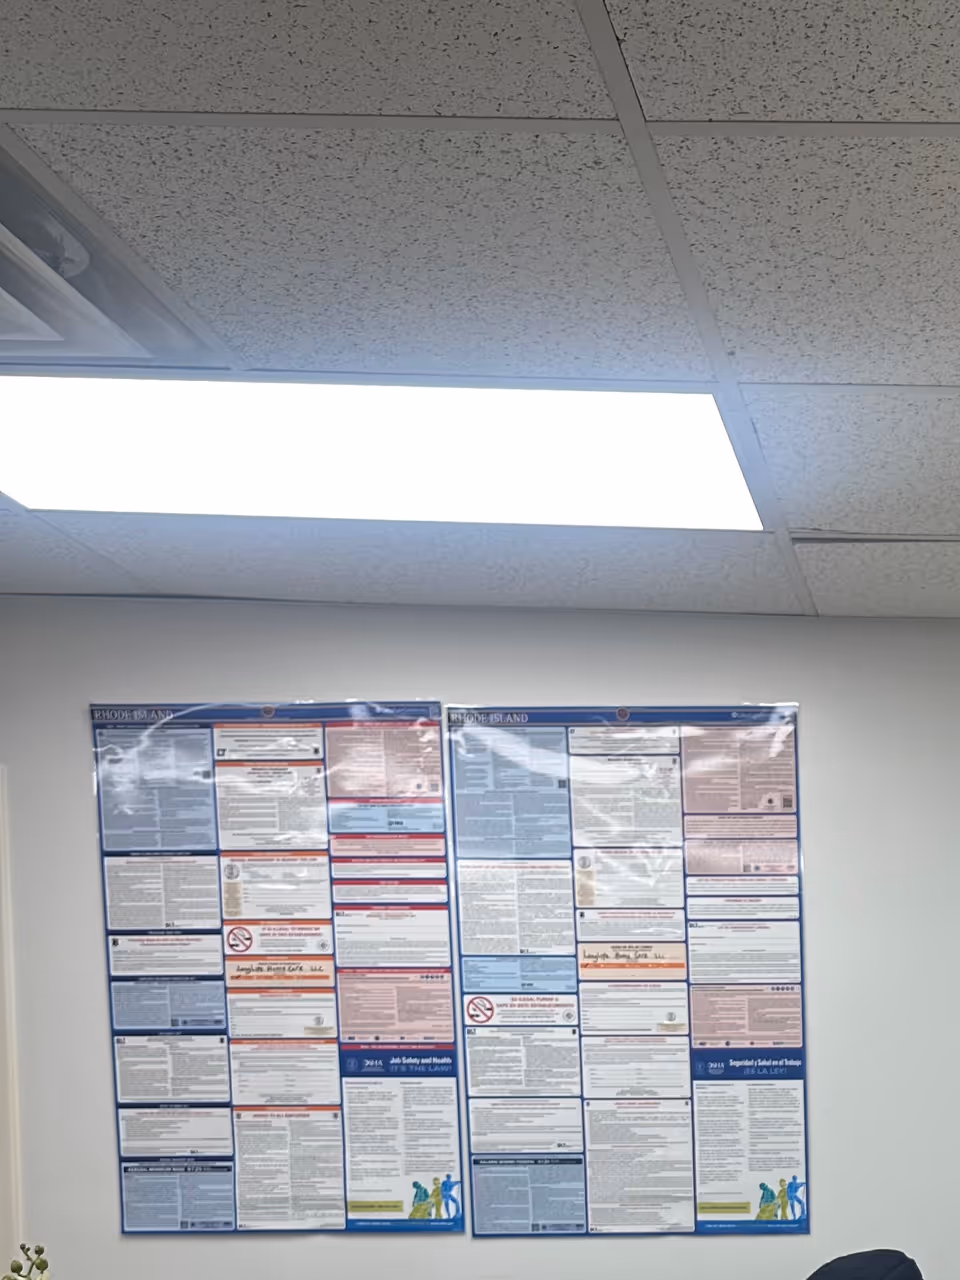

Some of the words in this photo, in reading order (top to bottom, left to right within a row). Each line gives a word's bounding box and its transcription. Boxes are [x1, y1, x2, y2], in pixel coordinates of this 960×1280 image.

[95, 709, 131, 720] RHODE
[132, 709, 174, 720] ISLAND
[450, 712, 487, 723] RHODE
[489, 713, 528, 723] ISLAND
[402, 1057, 420, 1065] Safety
[729, 1059, 754, 1067] Seguridad
[784, 1058, 802, 1067] Trabajo
